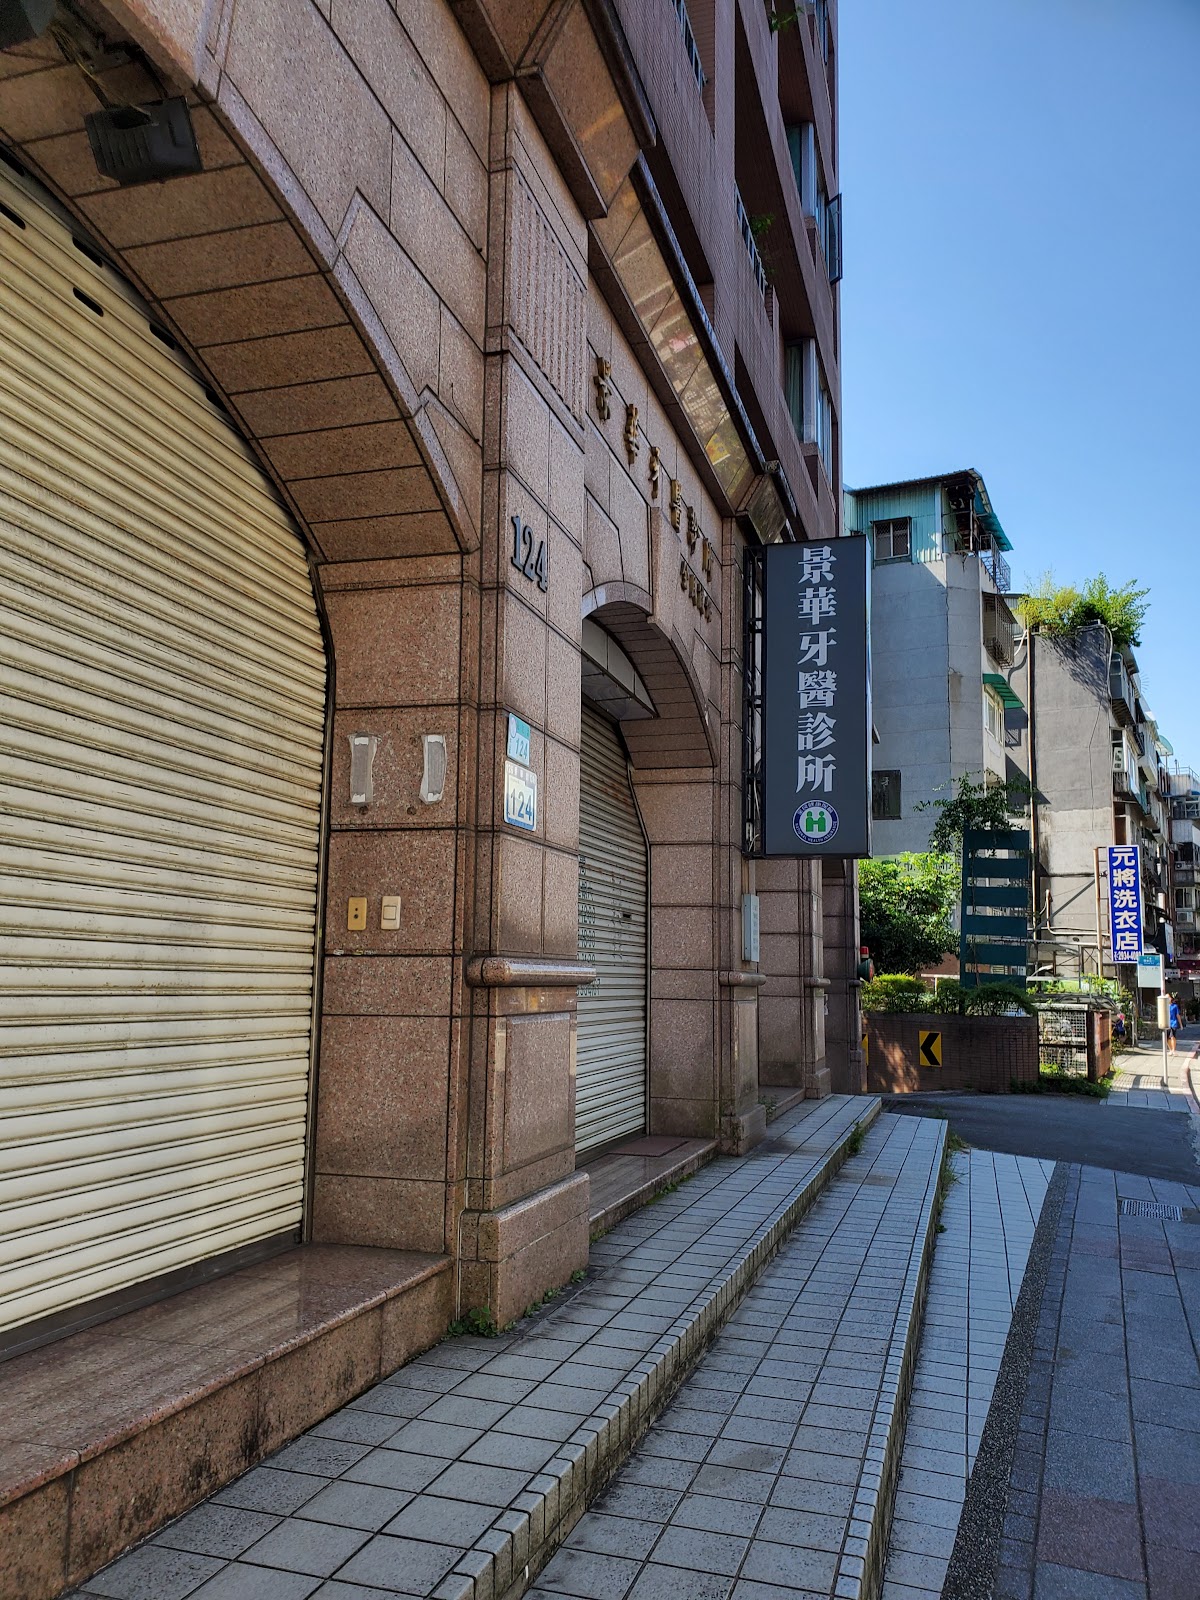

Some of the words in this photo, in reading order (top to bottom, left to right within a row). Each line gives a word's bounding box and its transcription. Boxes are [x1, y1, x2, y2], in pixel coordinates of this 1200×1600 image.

[511, 515, 548, 593] 124
[795, 545, 838, 794] 景華牙醫診所
[516, 738, 528, 760] 124
[511, 788, 533, 821] 124
[1112, 848, 1137, 950] 元將洗衣店
